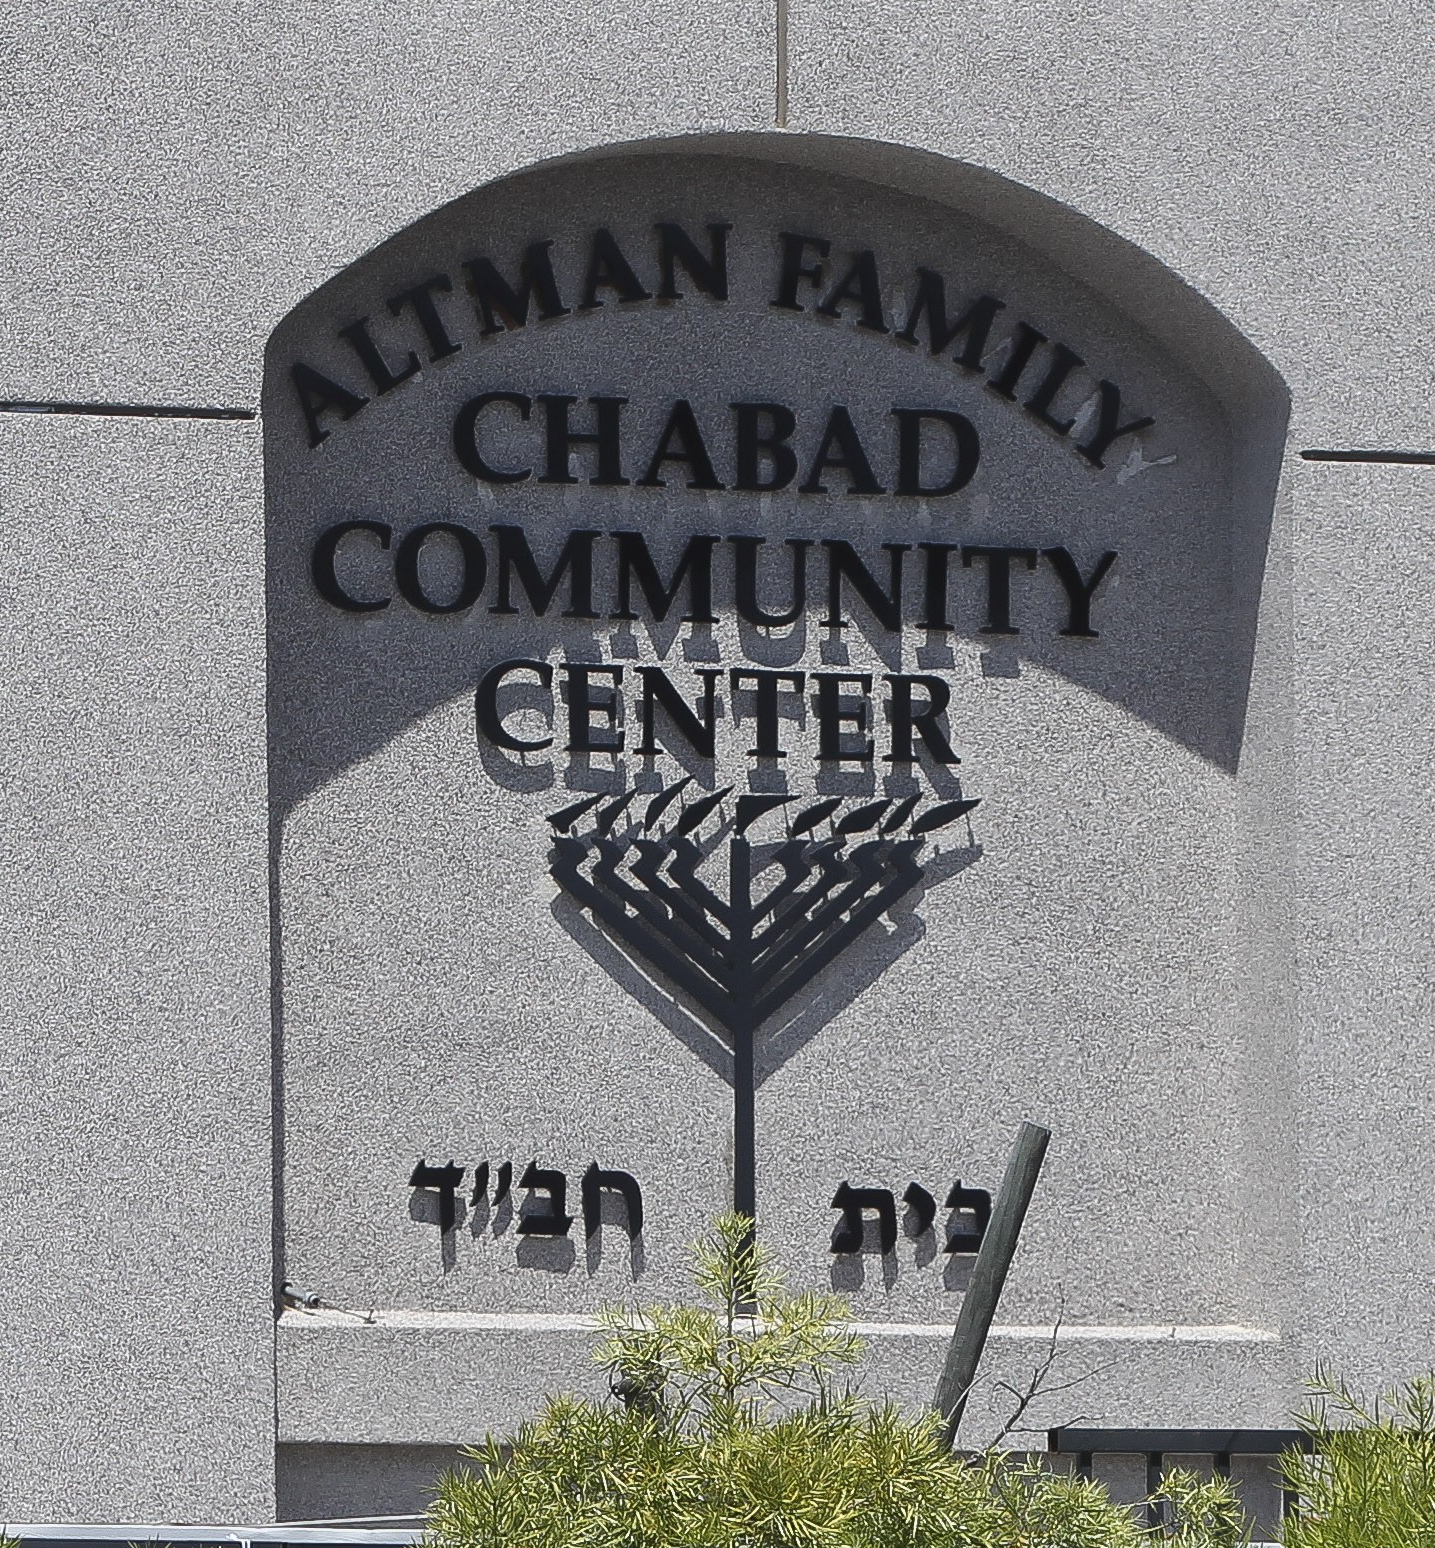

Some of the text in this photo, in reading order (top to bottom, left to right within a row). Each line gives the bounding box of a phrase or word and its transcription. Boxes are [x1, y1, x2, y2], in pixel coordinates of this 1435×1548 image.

[291, 222, 1157, 471] ALTMAN FAMILY
[452, 390, 981, 498] CHABAD
[309, 520, 1119, 638] COMMUNITY
[474, 658, 962, 765] CENTER
[829, 1178, 992, 1254] בית
